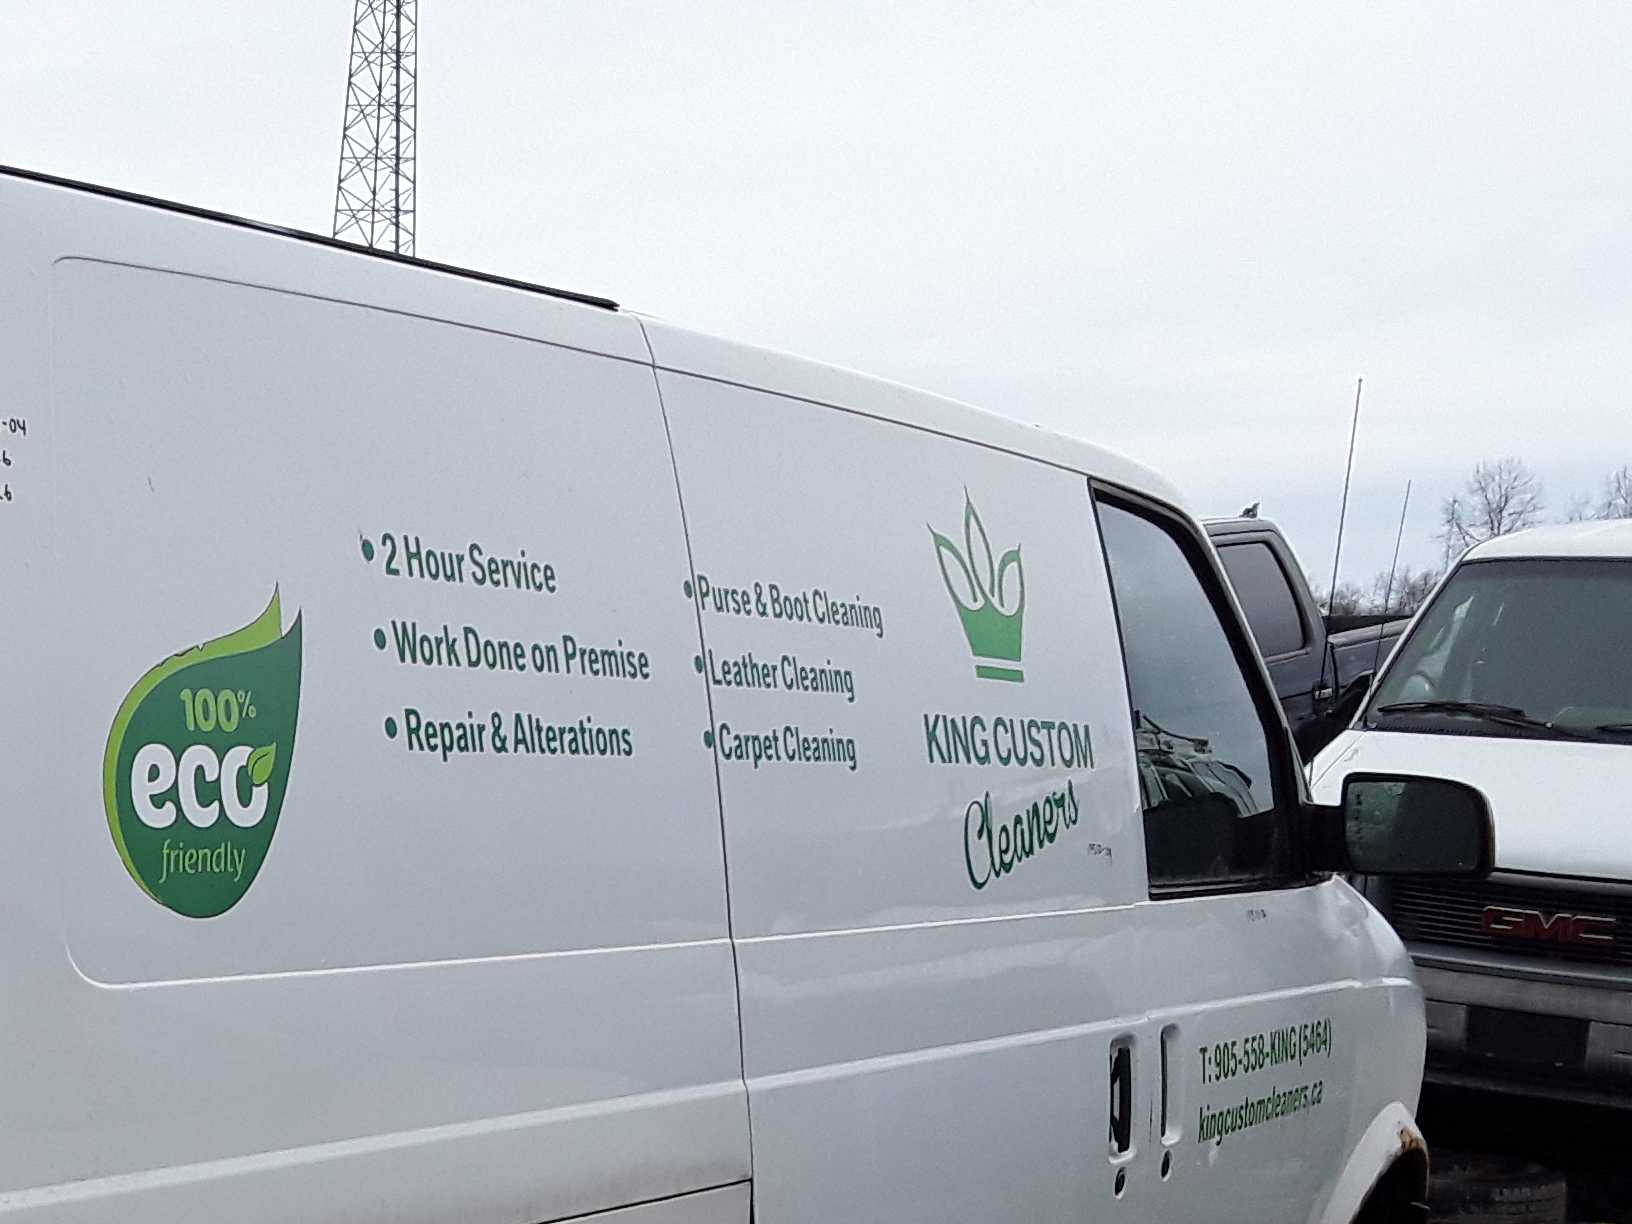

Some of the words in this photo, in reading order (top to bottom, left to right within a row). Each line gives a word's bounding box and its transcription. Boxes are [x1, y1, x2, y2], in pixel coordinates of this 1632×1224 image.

[380, 532, 401, 577] 2
[403, 534, 465, 583] Hour
[468, 542, 557, 594] Service
[696, 574, 752, 616] Purse
[753, 581, 769, 618] &
[768, 583, 811, 622] Boot
[812, 588, 884, 639] Cleaning
[390, 619, 461, 668] Work
[463, 625, 526, 672] Done
[530, 641, 560, 674] on
[562, 634, 650, 680] Premise
[707, 648, 778, 689] Leather
[780, 654, 856, 703] Cleaning
[179, 687, 257, 733] 100%
[403, 707, 486, 762] Repair
[491, 710, 509, 754] &
[513, 711, 633, 757] Alterations
[718, 722, 782, 770] Carpet
[782, 725, 857, 772] Cleaning
[923, 713, 991, 765] KING
[992, 716, 1095, 769] CUSTOM
[130, 743, 270, 829] eco
[158, 838, 247, 883] friendly
[963, 778, 1079, 890] Cleaners
[1482, 905, 1616, 945] GMC
[1214, 1025, 1296, 1082] 905-558-KING
[1298, 1016, 1332, 1067] (5464)
